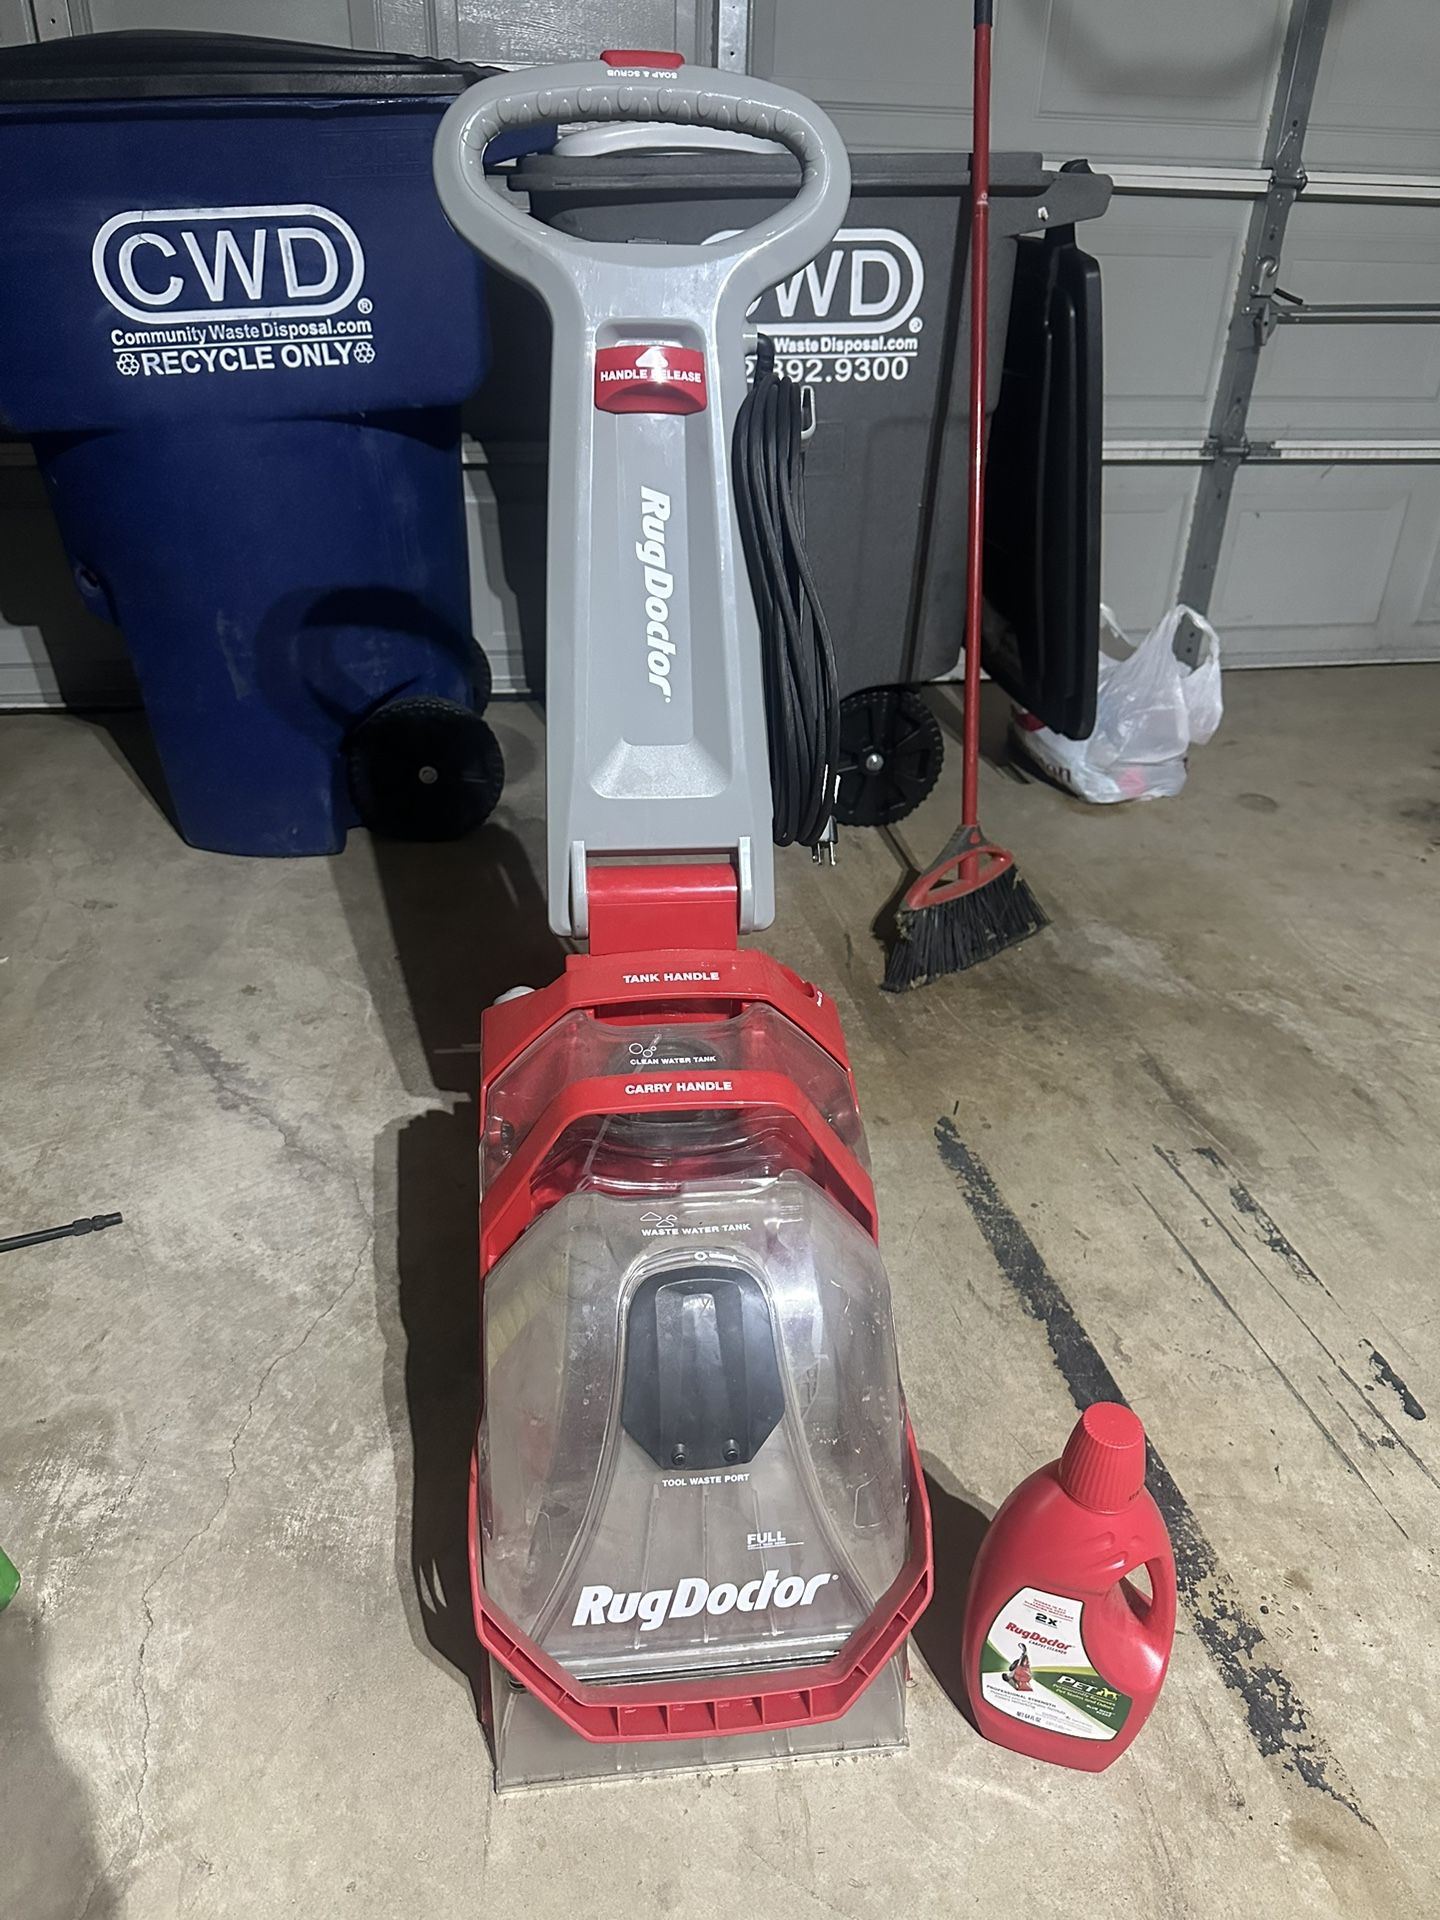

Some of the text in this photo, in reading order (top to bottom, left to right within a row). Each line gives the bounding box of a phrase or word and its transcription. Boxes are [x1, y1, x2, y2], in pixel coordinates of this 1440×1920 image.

[606, 69, 677, 80] SOAP & SCRUB
[118, 227, 338, 305] CWD
[775, 250, 901, 317] WD
[111, 319, 372, 346] Community Waste Disposal.com
[774, 336, 918, 355] Waste Disposal.com
[140, 342, 353, 376] RECYCLE ONLY
[600, 369, 648, 382] HANDLE
[635, 485, 676, 698] RugDoctor
[623, 972, 720, 984] TANK HANDLE
[630, 1055, 717, 1066] CLEAN WATER TANK
[624, 1081, 733, 1095] CARRY HANDLE
[641, 1223, 752, 1237] WASTE WATER TANK
[662, 1473, 750, 1487] TOOL WASTE PORT
[747, 1531, 786, 1544] FULL
[571, 1569, 831, 1631] RugDoctor
[1005, 1622, 1072, 1650] RugDoctor
